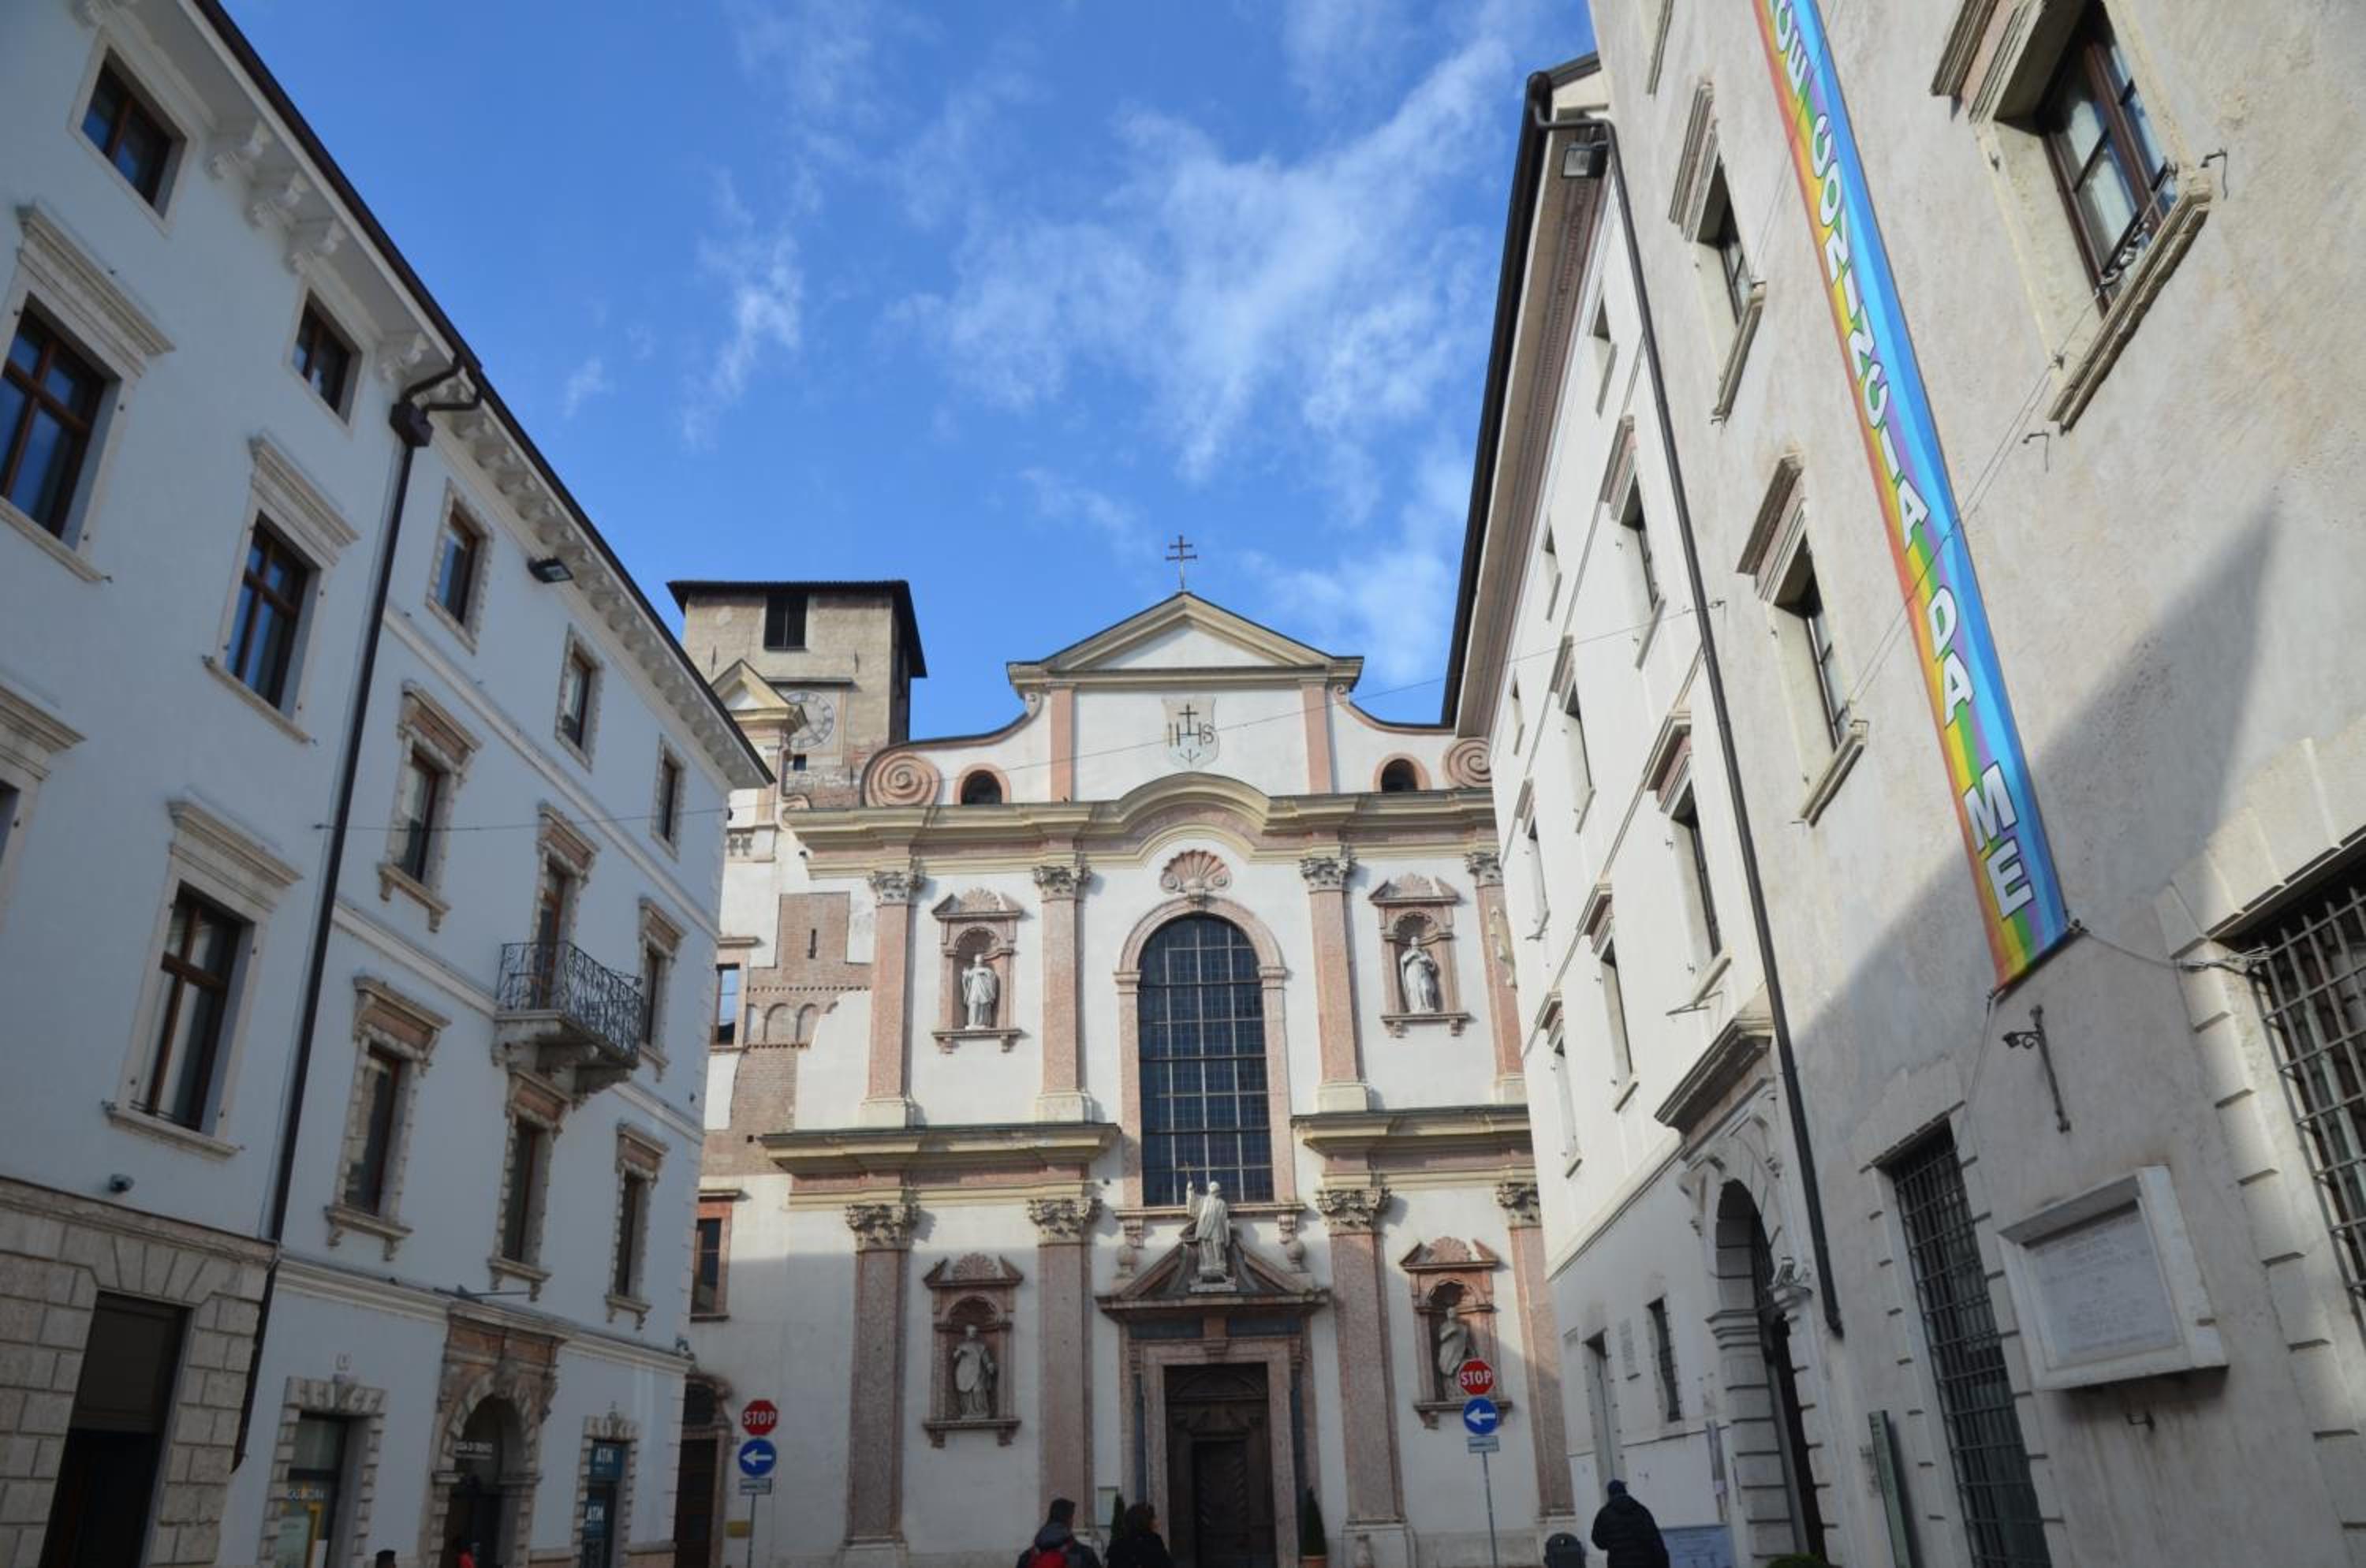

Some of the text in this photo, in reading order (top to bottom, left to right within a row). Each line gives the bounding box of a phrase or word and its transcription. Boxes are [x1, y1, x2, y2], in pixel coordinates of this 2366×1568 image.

[1771, 0, 1808, 98] CE
[1927, 585, 1975, 730] DA
[1963, 760, 2035, 921] ME
[1460, 1370, 1492, 1387] STOP
[744, 1410, 775, 1426] STOP
[586, 1505, 604, 1522] ATM
